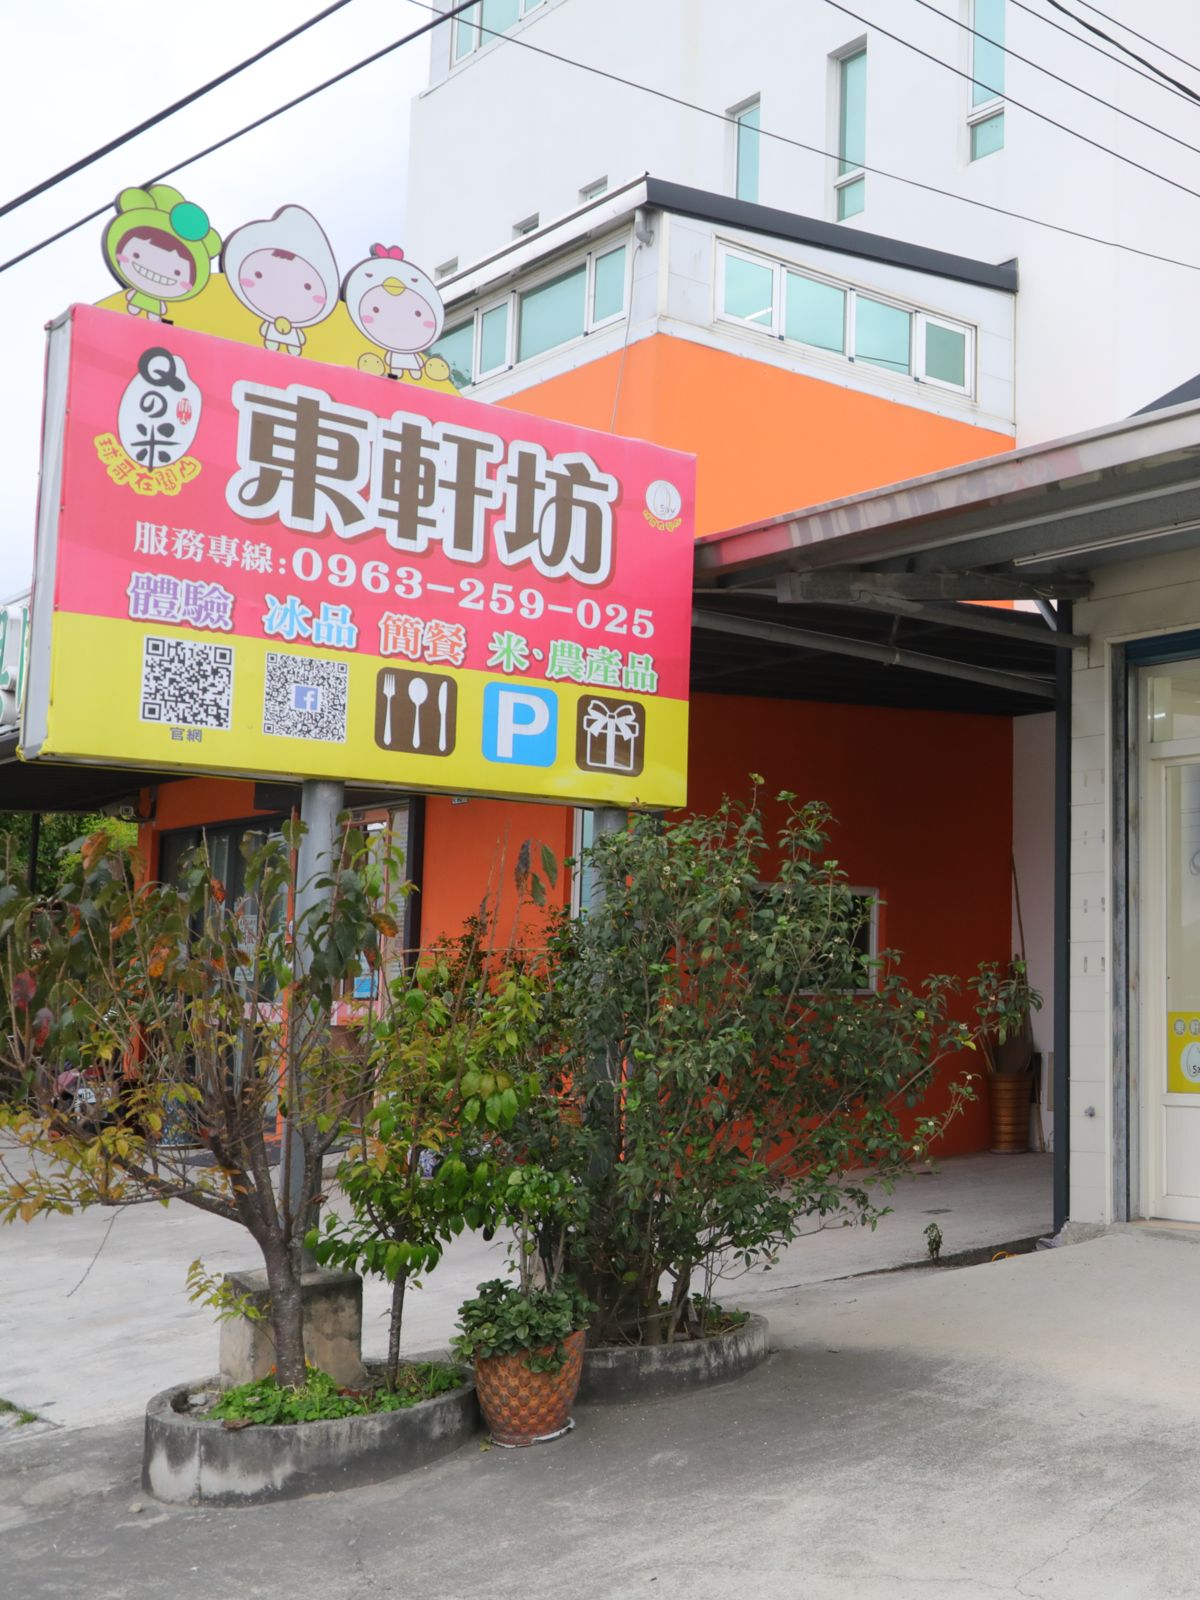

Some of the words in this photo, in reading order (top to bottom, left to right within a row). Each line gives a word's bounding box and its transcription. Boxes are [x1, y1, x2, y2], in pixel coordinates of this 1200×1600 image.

[131, 346, 185, 472] Qの米
[234, 388, 612, 577] 東軒坊
[129, 574, 232, 628] 體驗
[263, 595, 358, 648] 冰品
[379, 613, 466, 664] 簡餐
[170, 727, 203, 743] 官網
